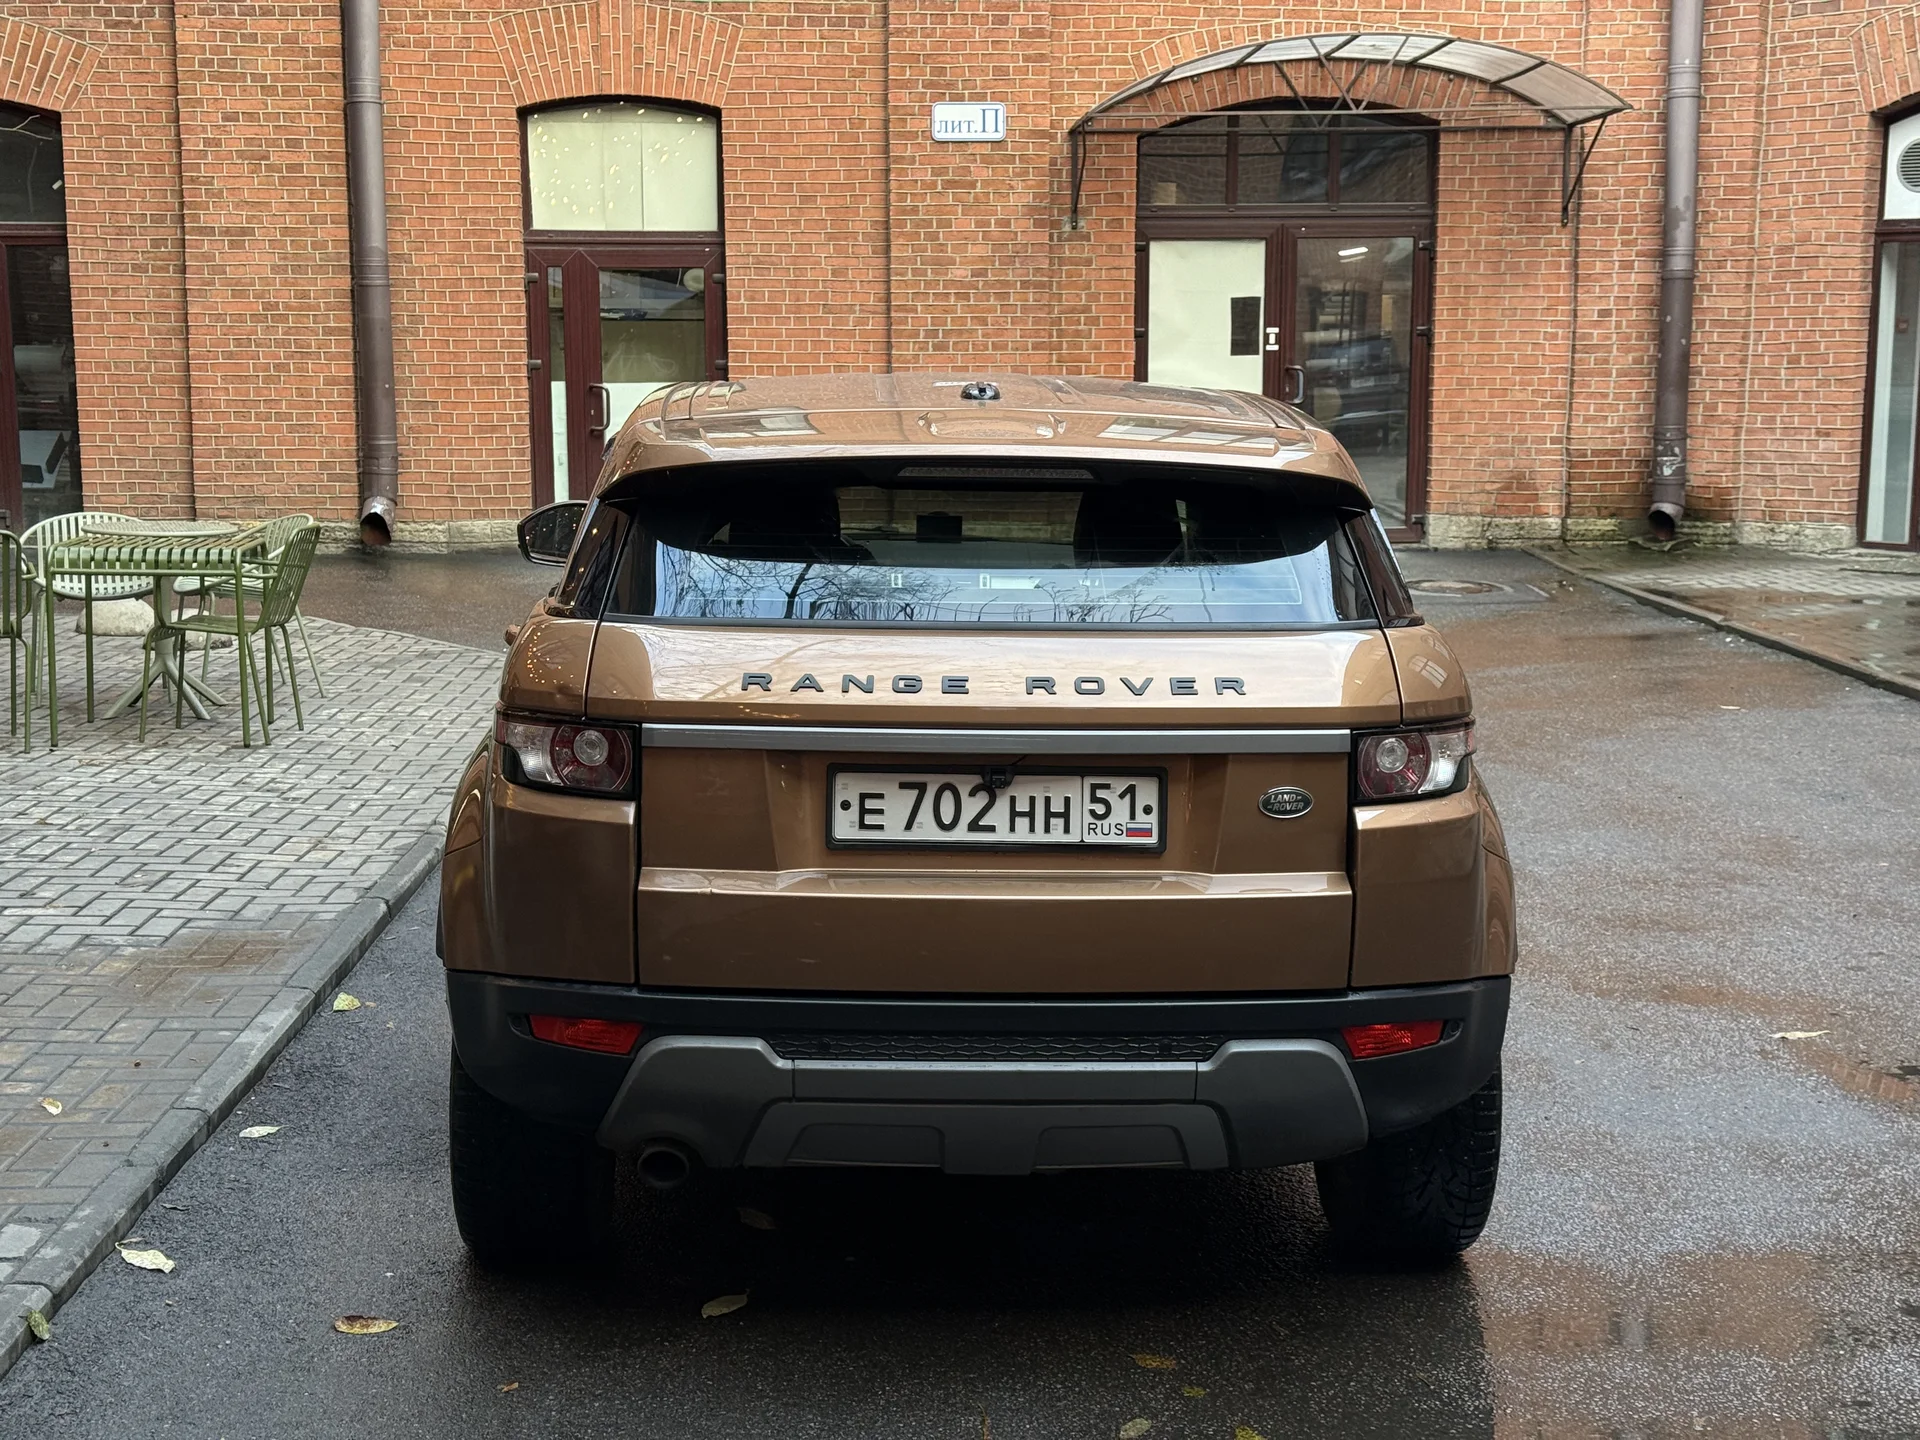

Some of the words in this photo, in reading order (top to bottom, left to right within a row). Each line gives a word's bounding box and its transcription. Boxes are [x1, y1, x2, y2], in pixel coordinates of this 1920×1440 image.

[741, 672, 970, 694] RANGE
[1025, 676, 1246, 696] ROVER
[1088, 782, 1137, 821] 51
[1087, 822, 1124, 837] RUS
